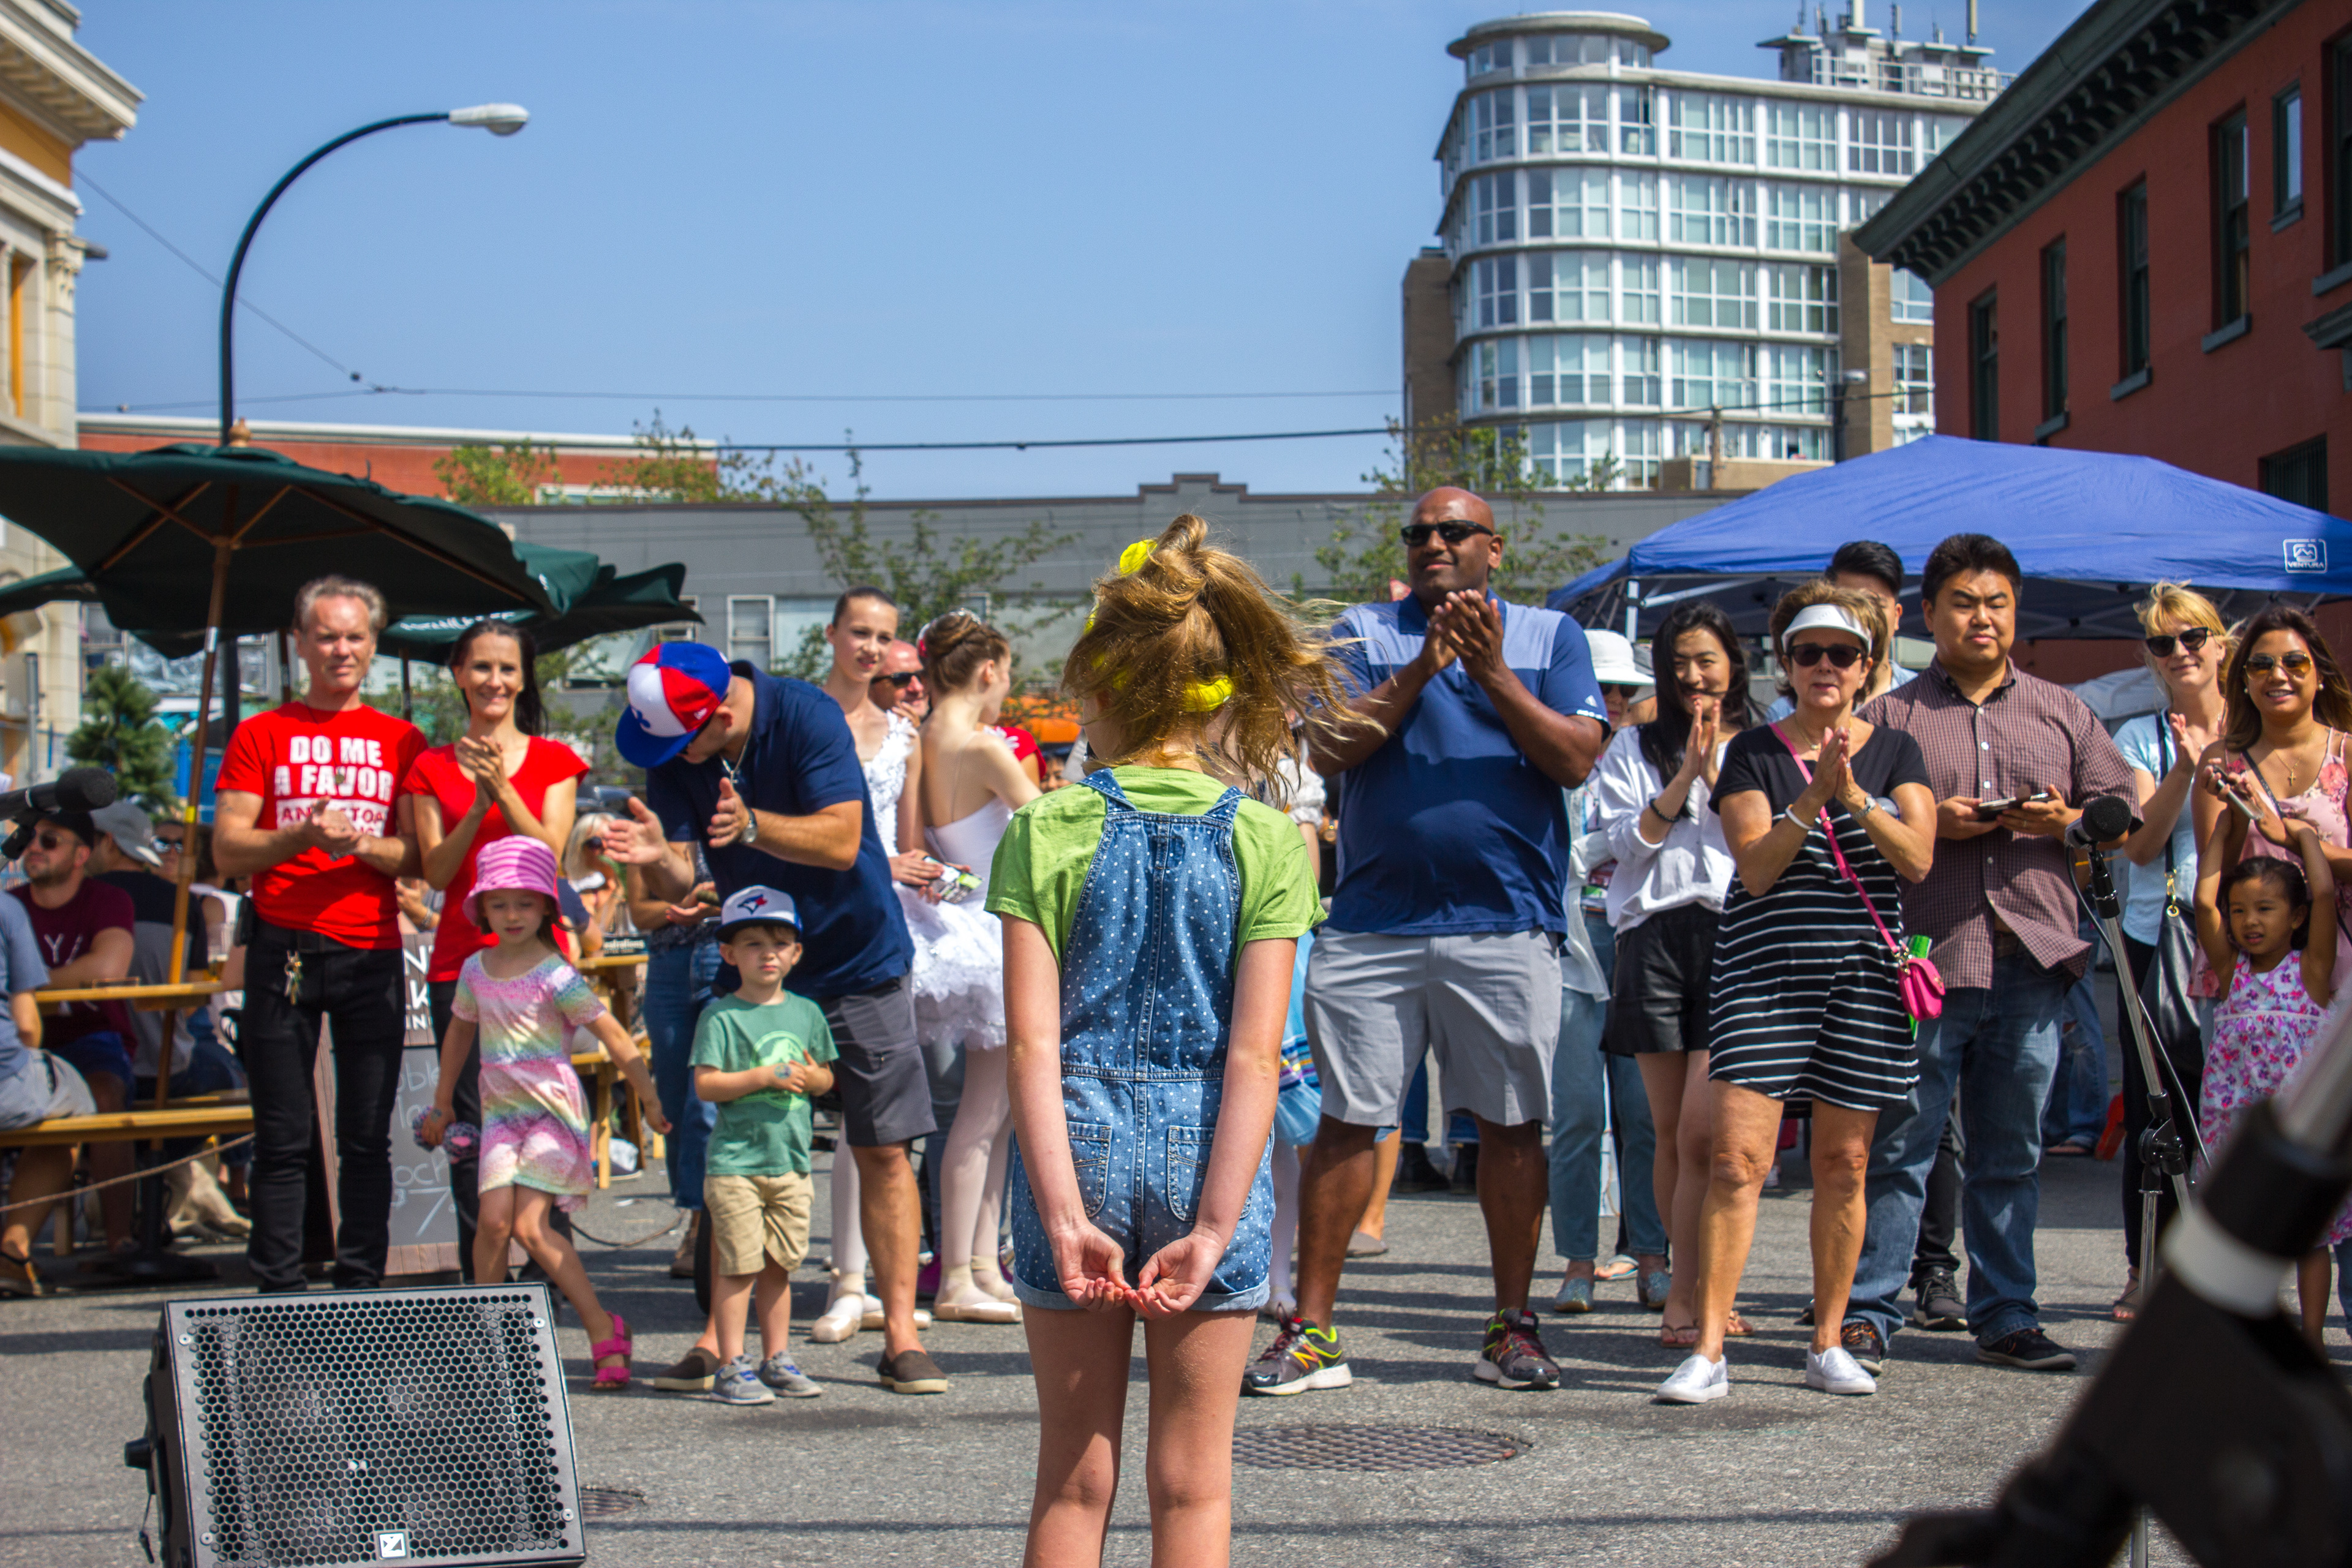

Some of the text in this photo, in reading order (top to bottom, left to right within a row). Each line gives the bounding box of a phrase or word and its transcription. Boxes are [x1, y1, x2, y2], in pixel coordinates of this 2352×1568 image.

[289, 735, 383, 768] DO ME
[274, 764, 394, 803] A FAVOR
[281, 805, 312, 822] AN
